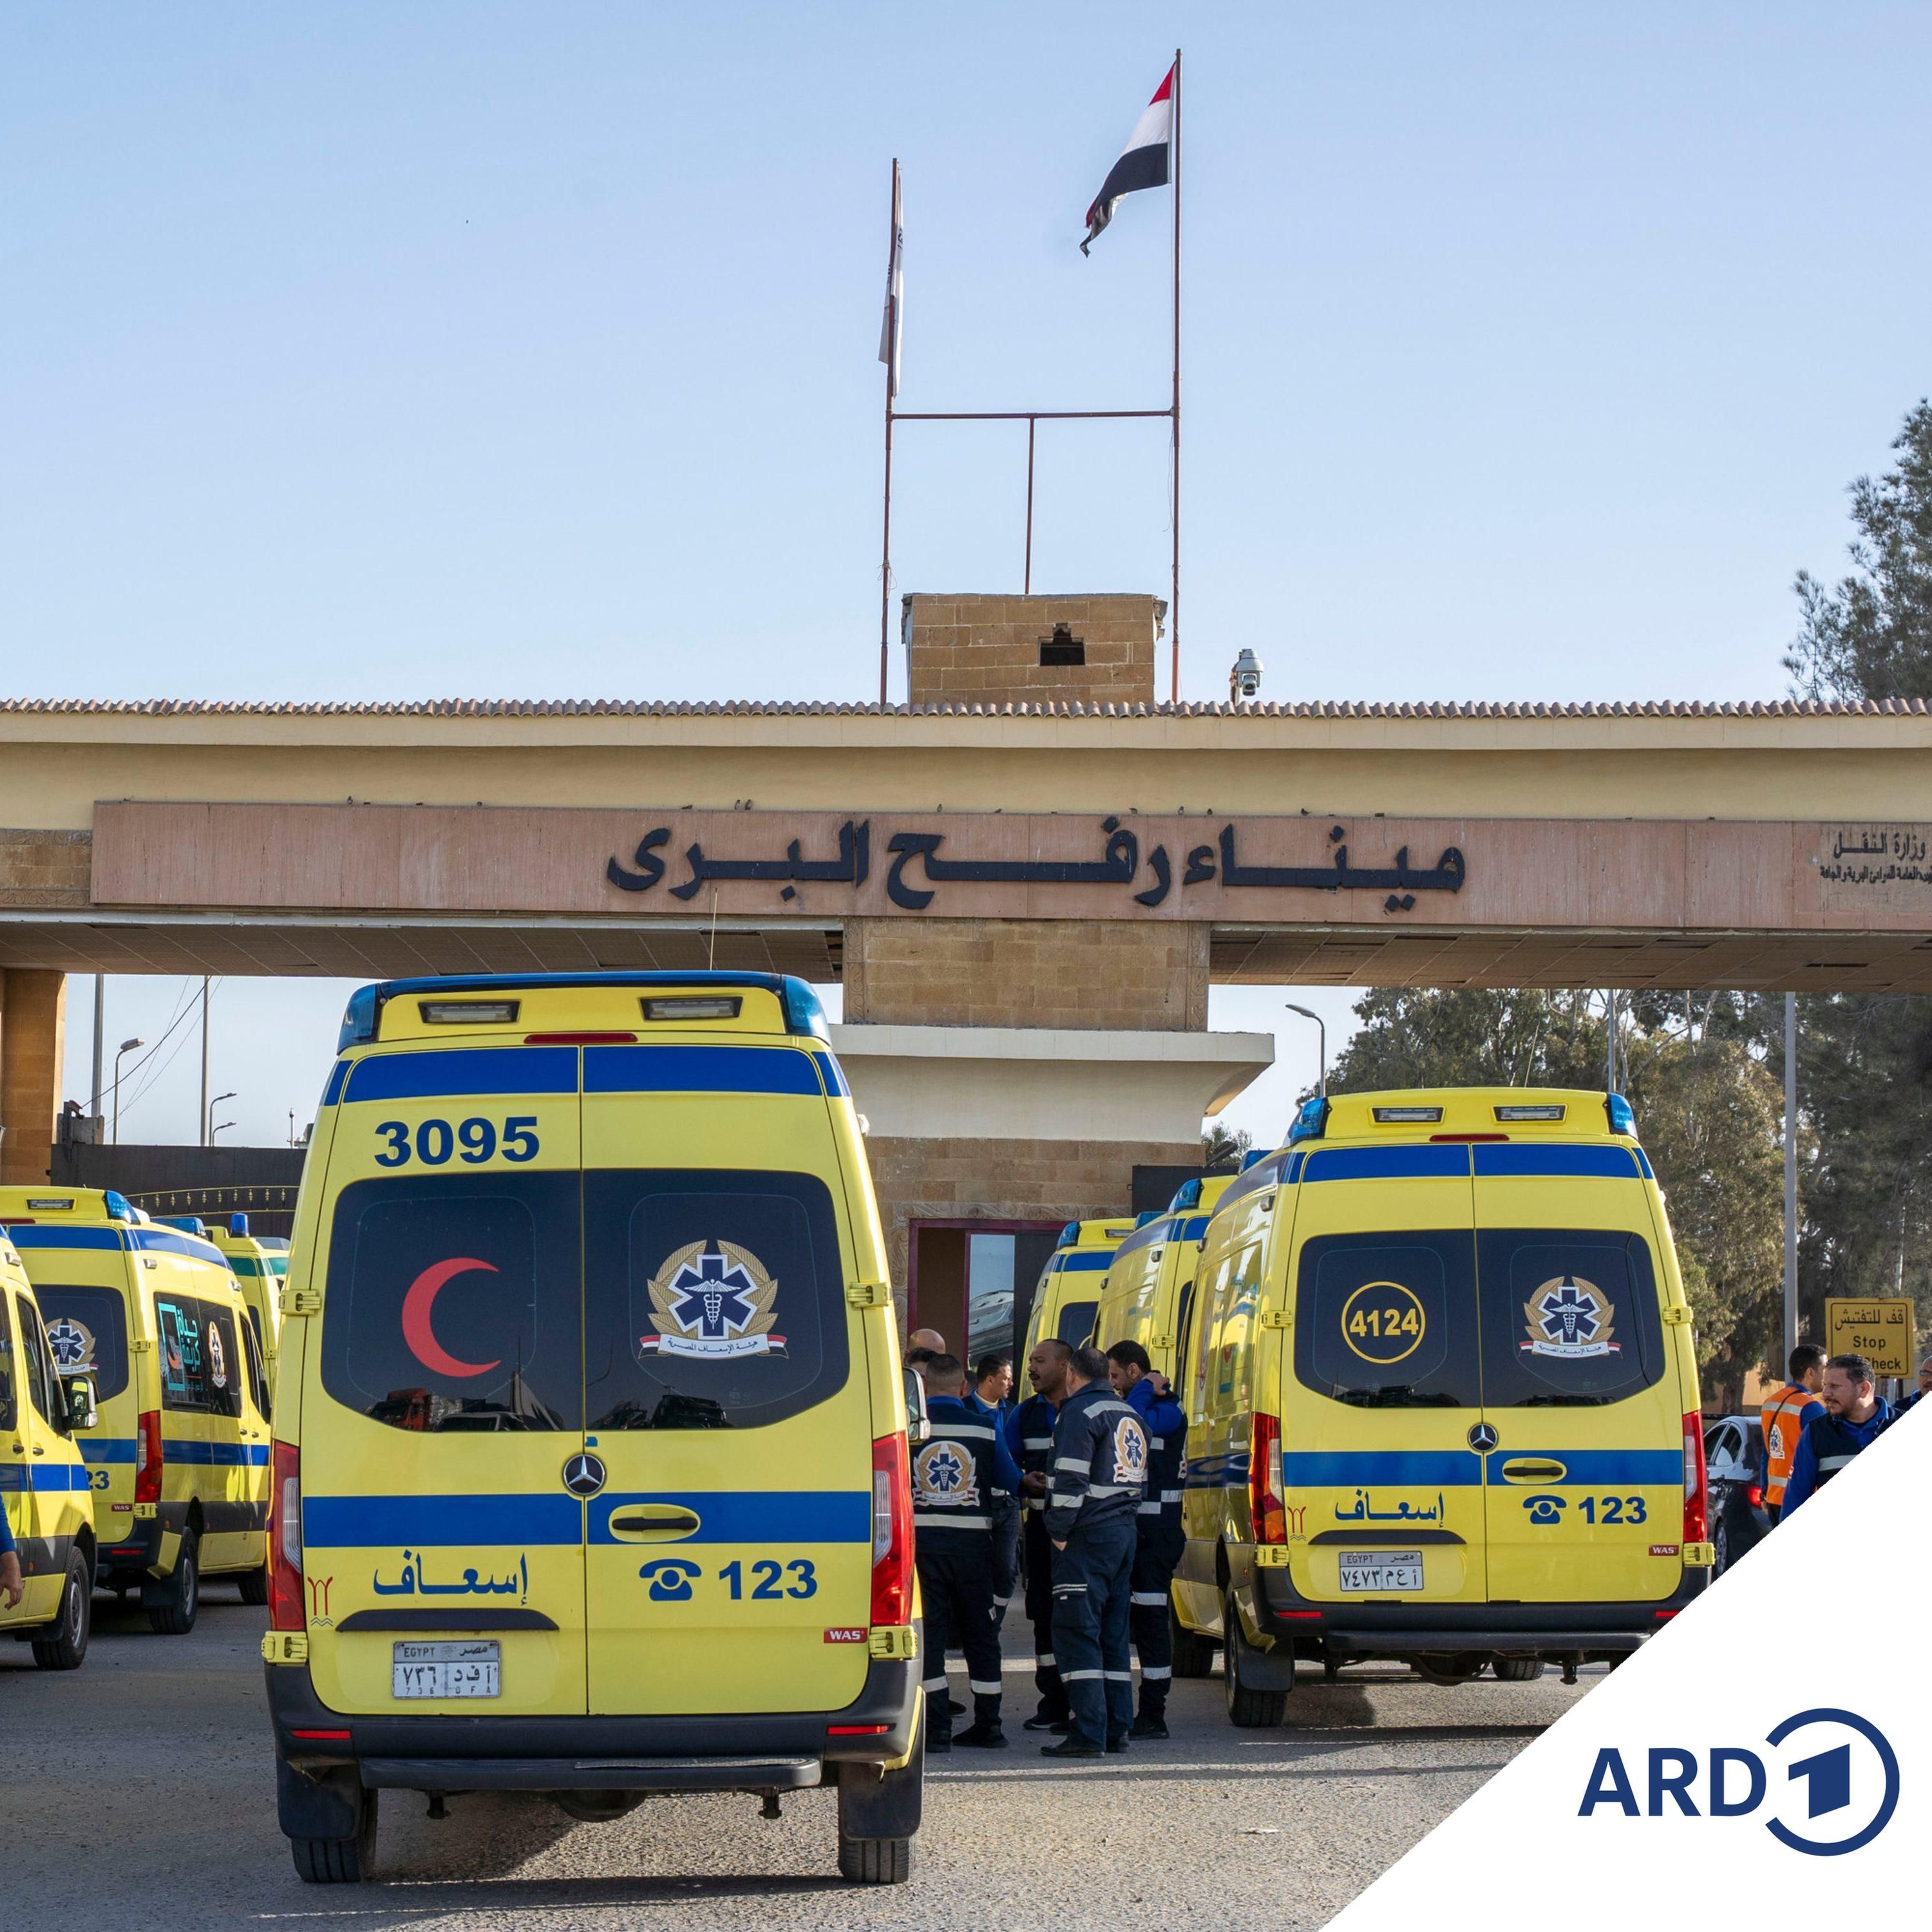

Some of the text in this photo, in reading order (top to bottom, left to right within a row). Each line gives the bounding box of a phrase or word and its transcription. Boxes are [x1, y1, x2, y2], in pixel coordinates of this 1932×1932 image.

[1833, 831, 1926, 861] وزارة النقل
[886, 815, 1171, 909] رفح
[1183, 823, 1466, 912] ميناء
[374, 1116, 540, 1168] 3095
[1350, 1309, 1419, 1337] 4124
[1835, 1309, 1904, 1331] قف للتفتيش
[1853, 1336, 1886, 1351] Stop
[1865, 1356, 1902, 1369] heck
[1335, 1489, 1444, 1528] إسعاف
[1578, 1497, 1647, 1524] 123
[1347, 1555, 1374, 1564] EGYPT
[1390, 1555, 1414, 1563] مصر
[1653, 1546, 1675, 1555] WAS
[374, 1549, 528, 1605] إسعاف
[719, 1559, 818, 1600] 123
[829, 1630, 861, 1640] WAS
[404, 1647, 435, 1658] EGYPT
[459, 1645, 488, 1656] مصر
